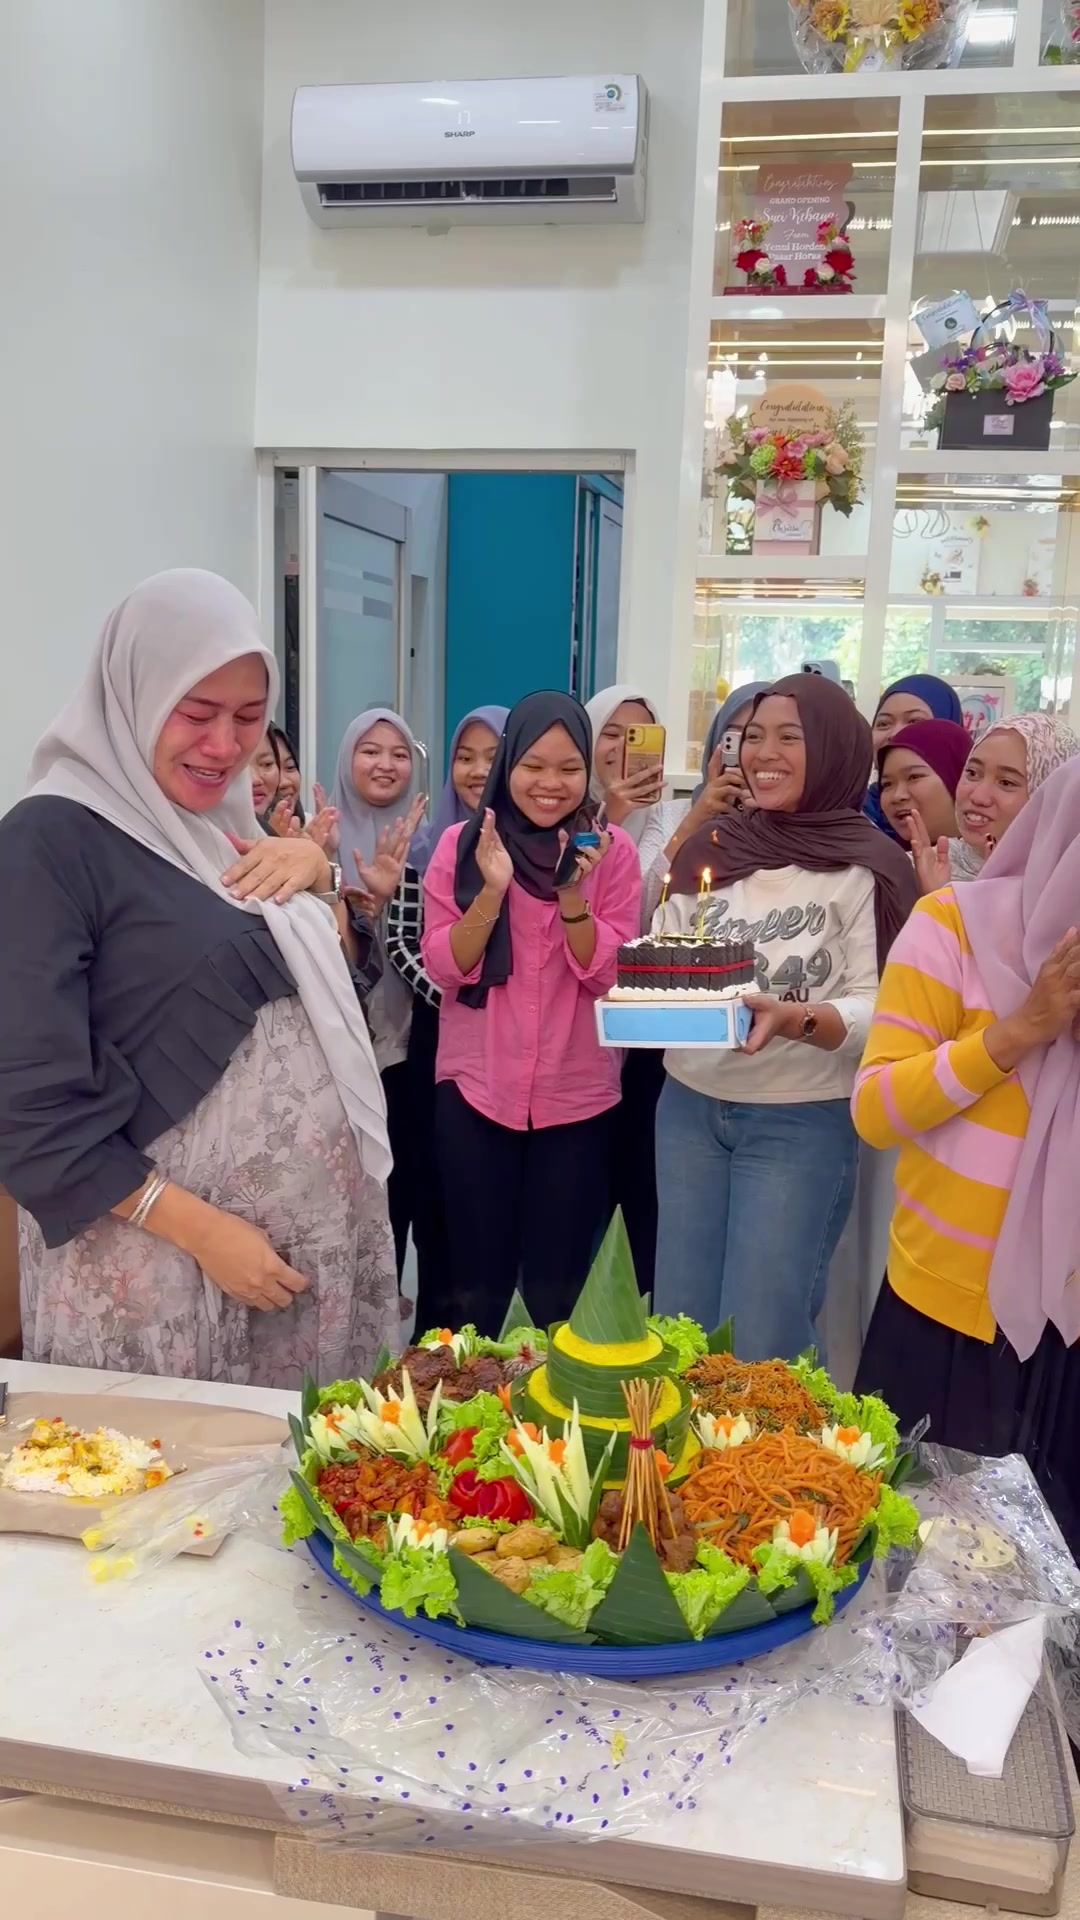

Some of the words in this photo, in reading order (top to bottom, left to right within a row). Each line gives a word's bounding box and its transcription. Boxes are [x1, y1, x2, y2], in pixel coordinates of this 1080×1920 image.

[443, 130, 476, 138] SHARP
[769, 196, 796, 205] GRAND
[796, 195, 831, 205] OPENING
[760, 399, 825, 417] Congratulations
[778, 987, 810, 1003] AU
